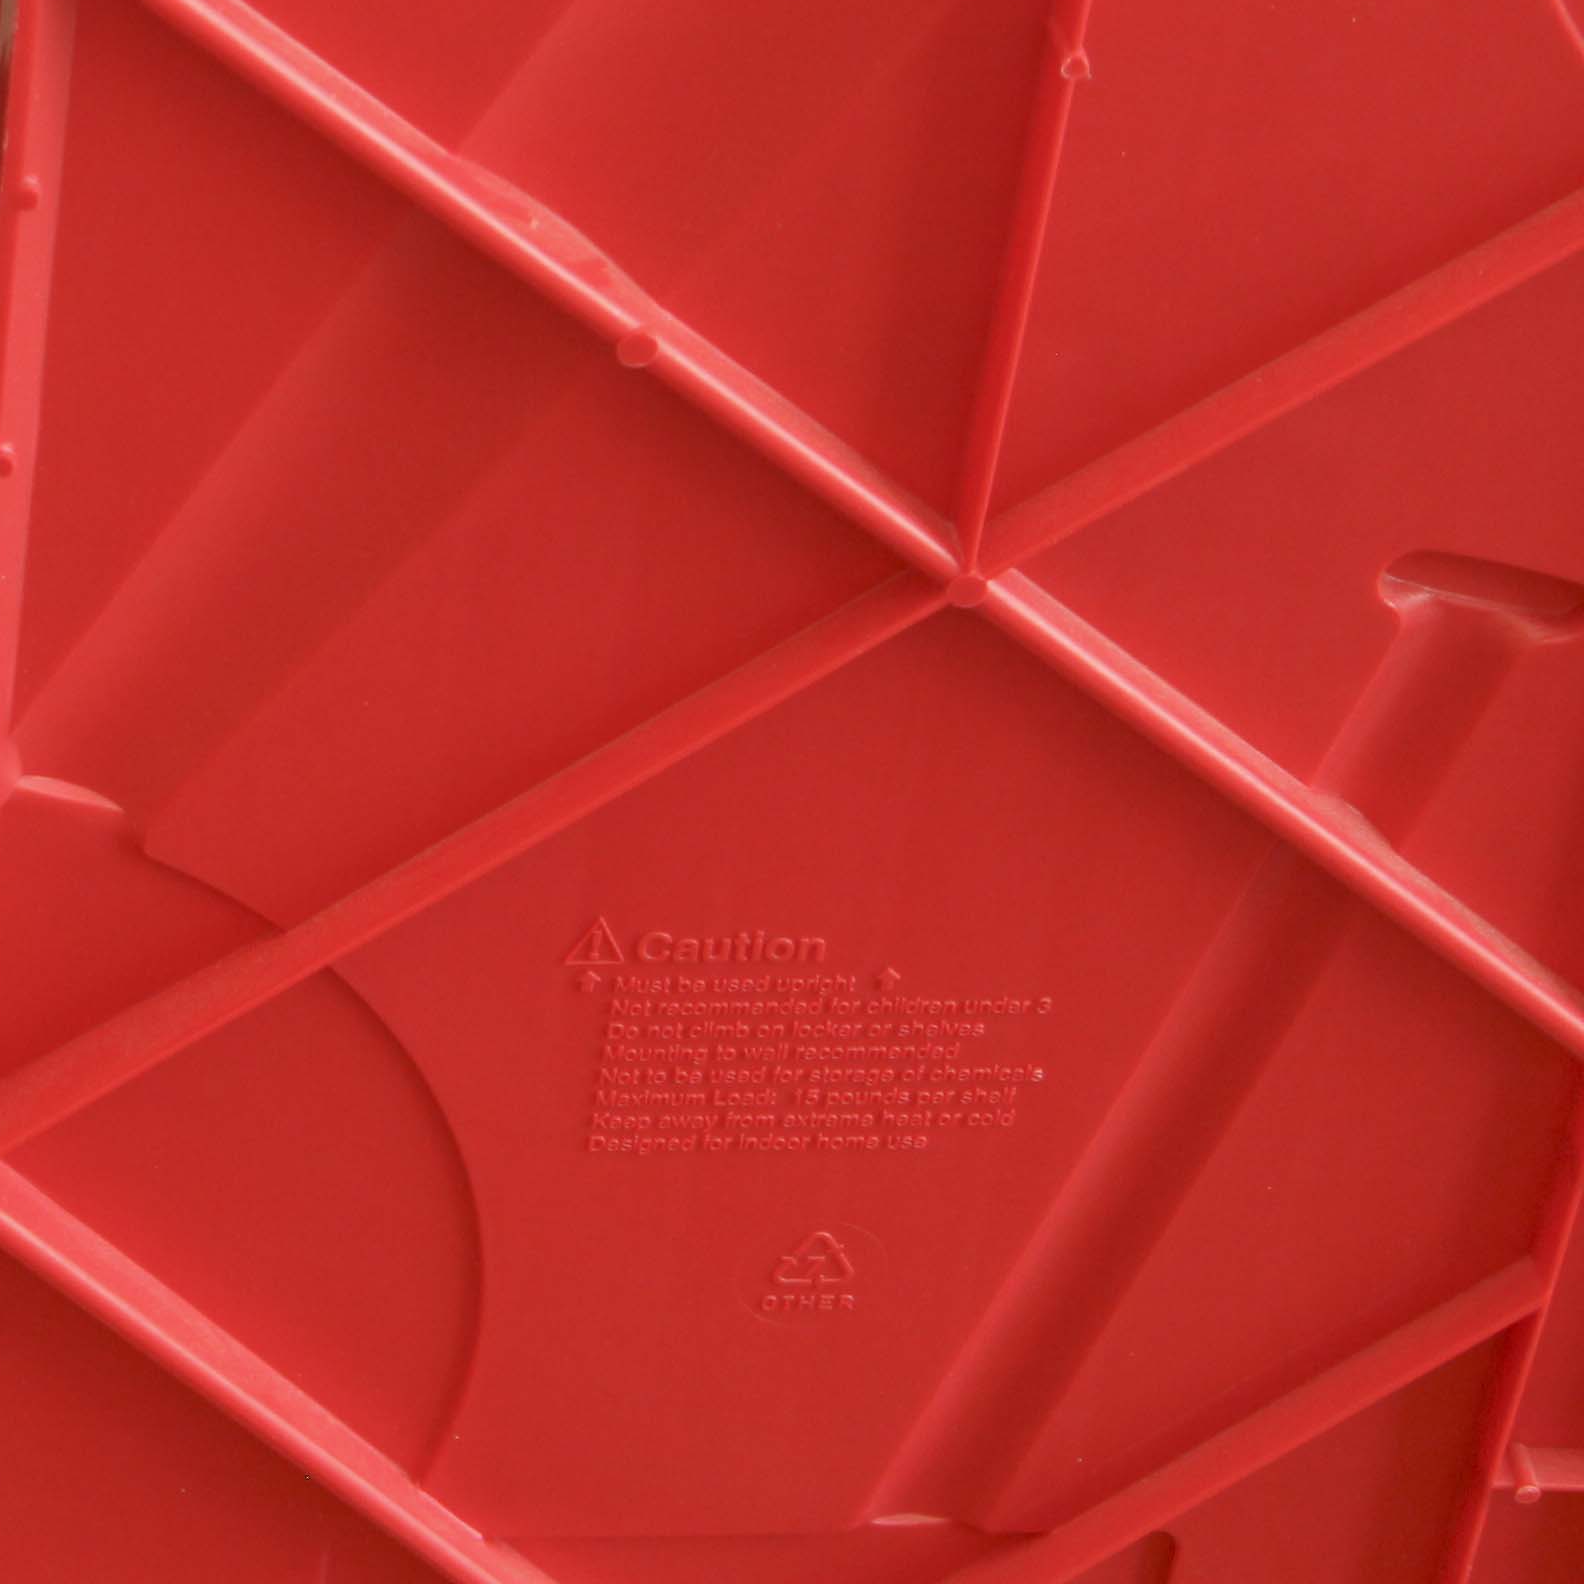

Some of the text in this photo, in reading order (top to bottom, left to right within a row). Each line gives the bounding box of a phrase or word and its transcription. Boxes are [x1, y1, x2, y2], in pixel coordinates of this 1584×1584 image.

[637, 929, 827, 963] Caution
[614, 975, 857, 997] Must be used upright
[610, 995, 1053, 1017] Not recommended for children under 3
[607, 1020, 985, 1040] Do not climb on locker or shelves
[603, 1042, 960, 1065] Mounting to wall recommended
[599, 1063, 1045, 1086] Not to be used for storage of chemicals
[595, 1088, 707, 1107] Maximum
[826, 1087, 911, 1106] pounds
[917, 1090, 956, 1107] per
[959, 1087, 1018, 1105] shelf
[591, 1108, 1016, 1133] Keep away from extreme heat or cold
[588, 1134, 697, 1156] Designed
[702, 1133, 734, 1151] for
[816, 1132, 881, 1151] home
[887, 1133, 929, 1150] use
[761, 1294, 857, 1313] OTHER
